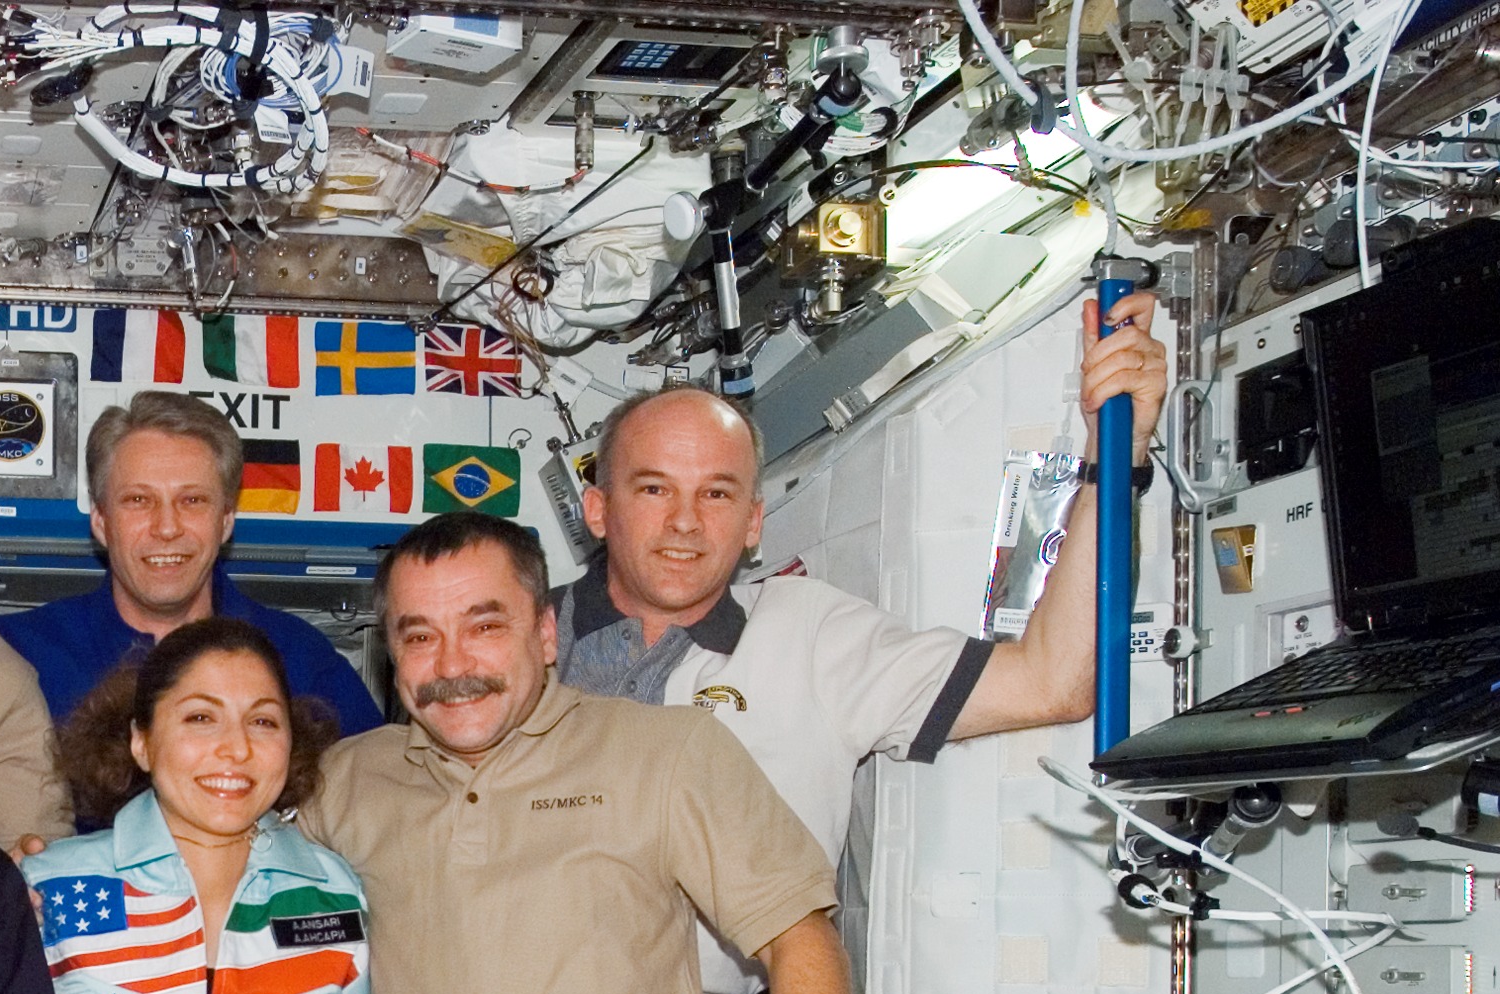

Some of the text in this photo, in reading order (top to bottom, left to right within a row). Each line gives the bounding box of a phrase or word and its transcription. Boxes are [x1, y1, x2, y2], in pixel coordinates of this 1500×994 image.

[1004, 501, 1018, 538] Drinking
[1286, 501, 1314, 523] HRF
[531, 794, 603, 811] ISS/MKC 14
